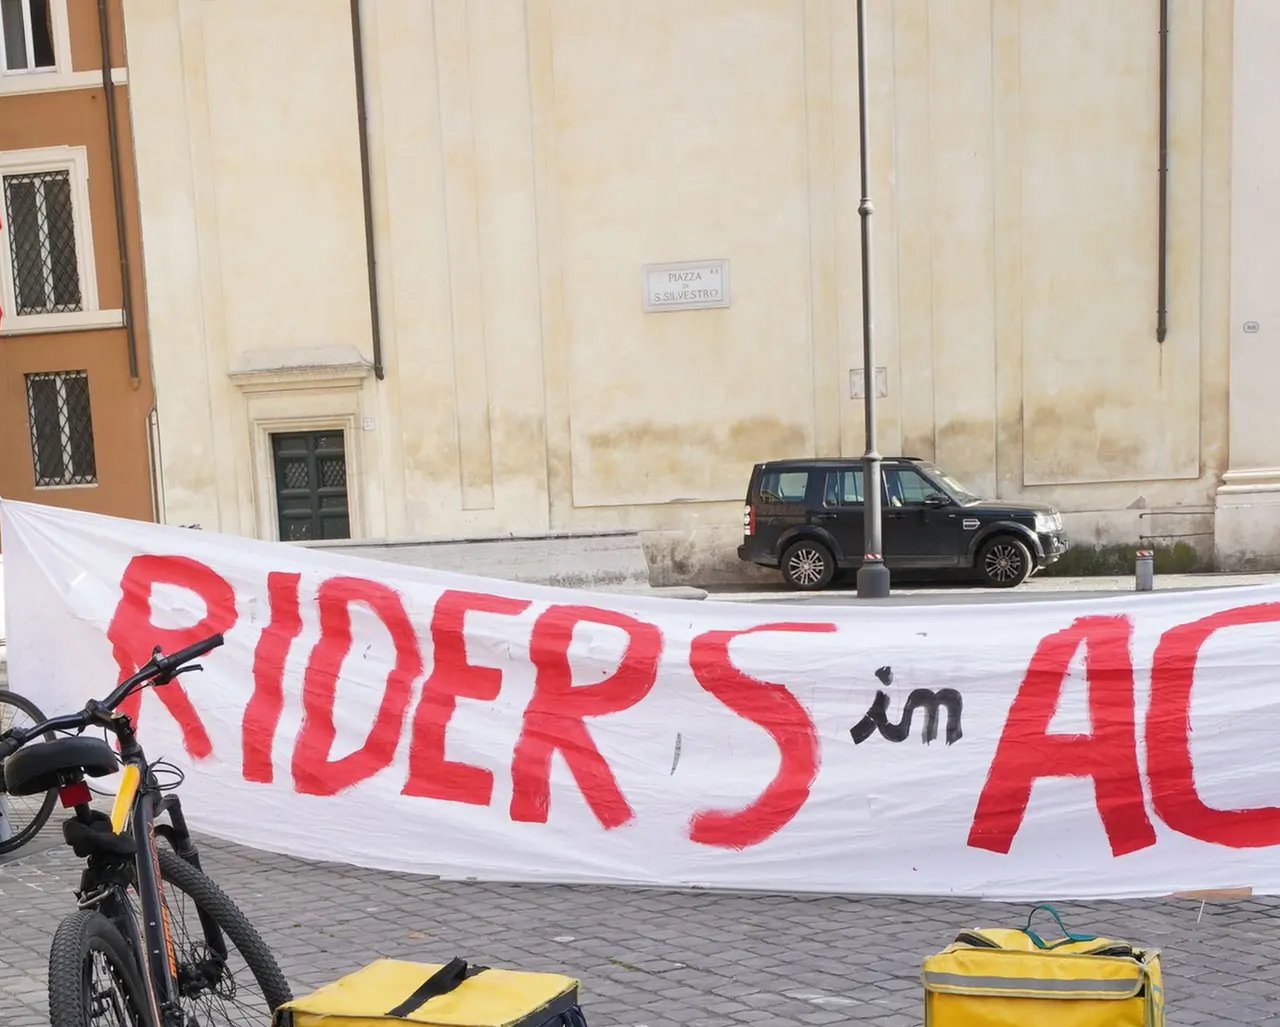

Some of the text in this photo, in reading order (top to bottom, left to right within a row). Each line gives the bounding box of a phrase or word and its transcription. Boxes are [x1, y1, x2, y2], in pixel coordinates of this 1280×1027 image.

[668, 271, 702, 283] PIAZZA
[663, 288, 719, 302] SILVESTRO
[107, 552, 837, 850] RIDERS
[849, 664, 963, 745] in
